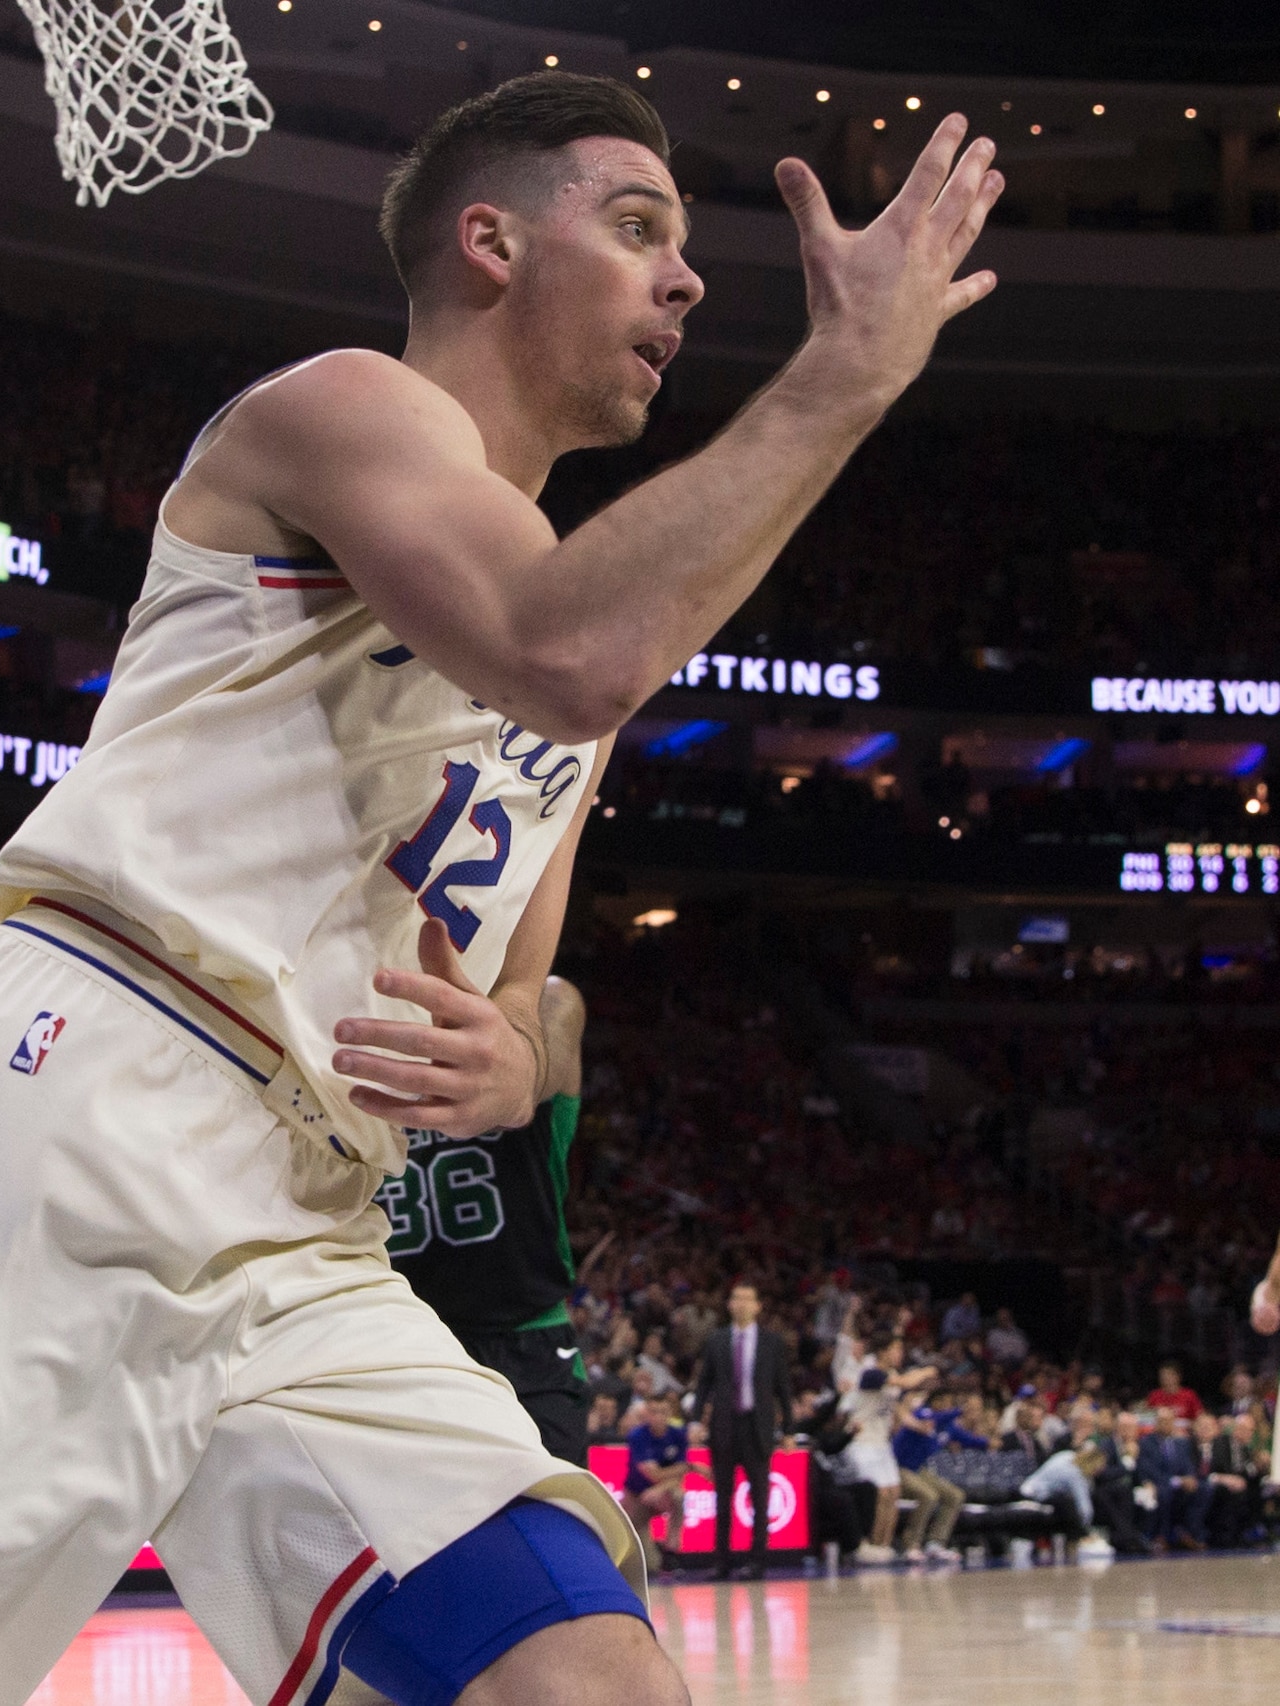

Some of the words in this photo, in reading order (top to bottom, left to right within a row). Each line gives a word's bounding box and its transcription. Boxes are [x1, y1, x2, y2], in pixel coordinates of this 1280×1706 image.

[671, 653, 880, 700] FTKINGS
[1092, 677, 1216, 713] BECAUSE
[1218, 680, 1280, 715] YOU
[30, 741, 83, 787] JUS
[383, 760, 511, 953] 12
[374, 1146, 505, 1257] 36
